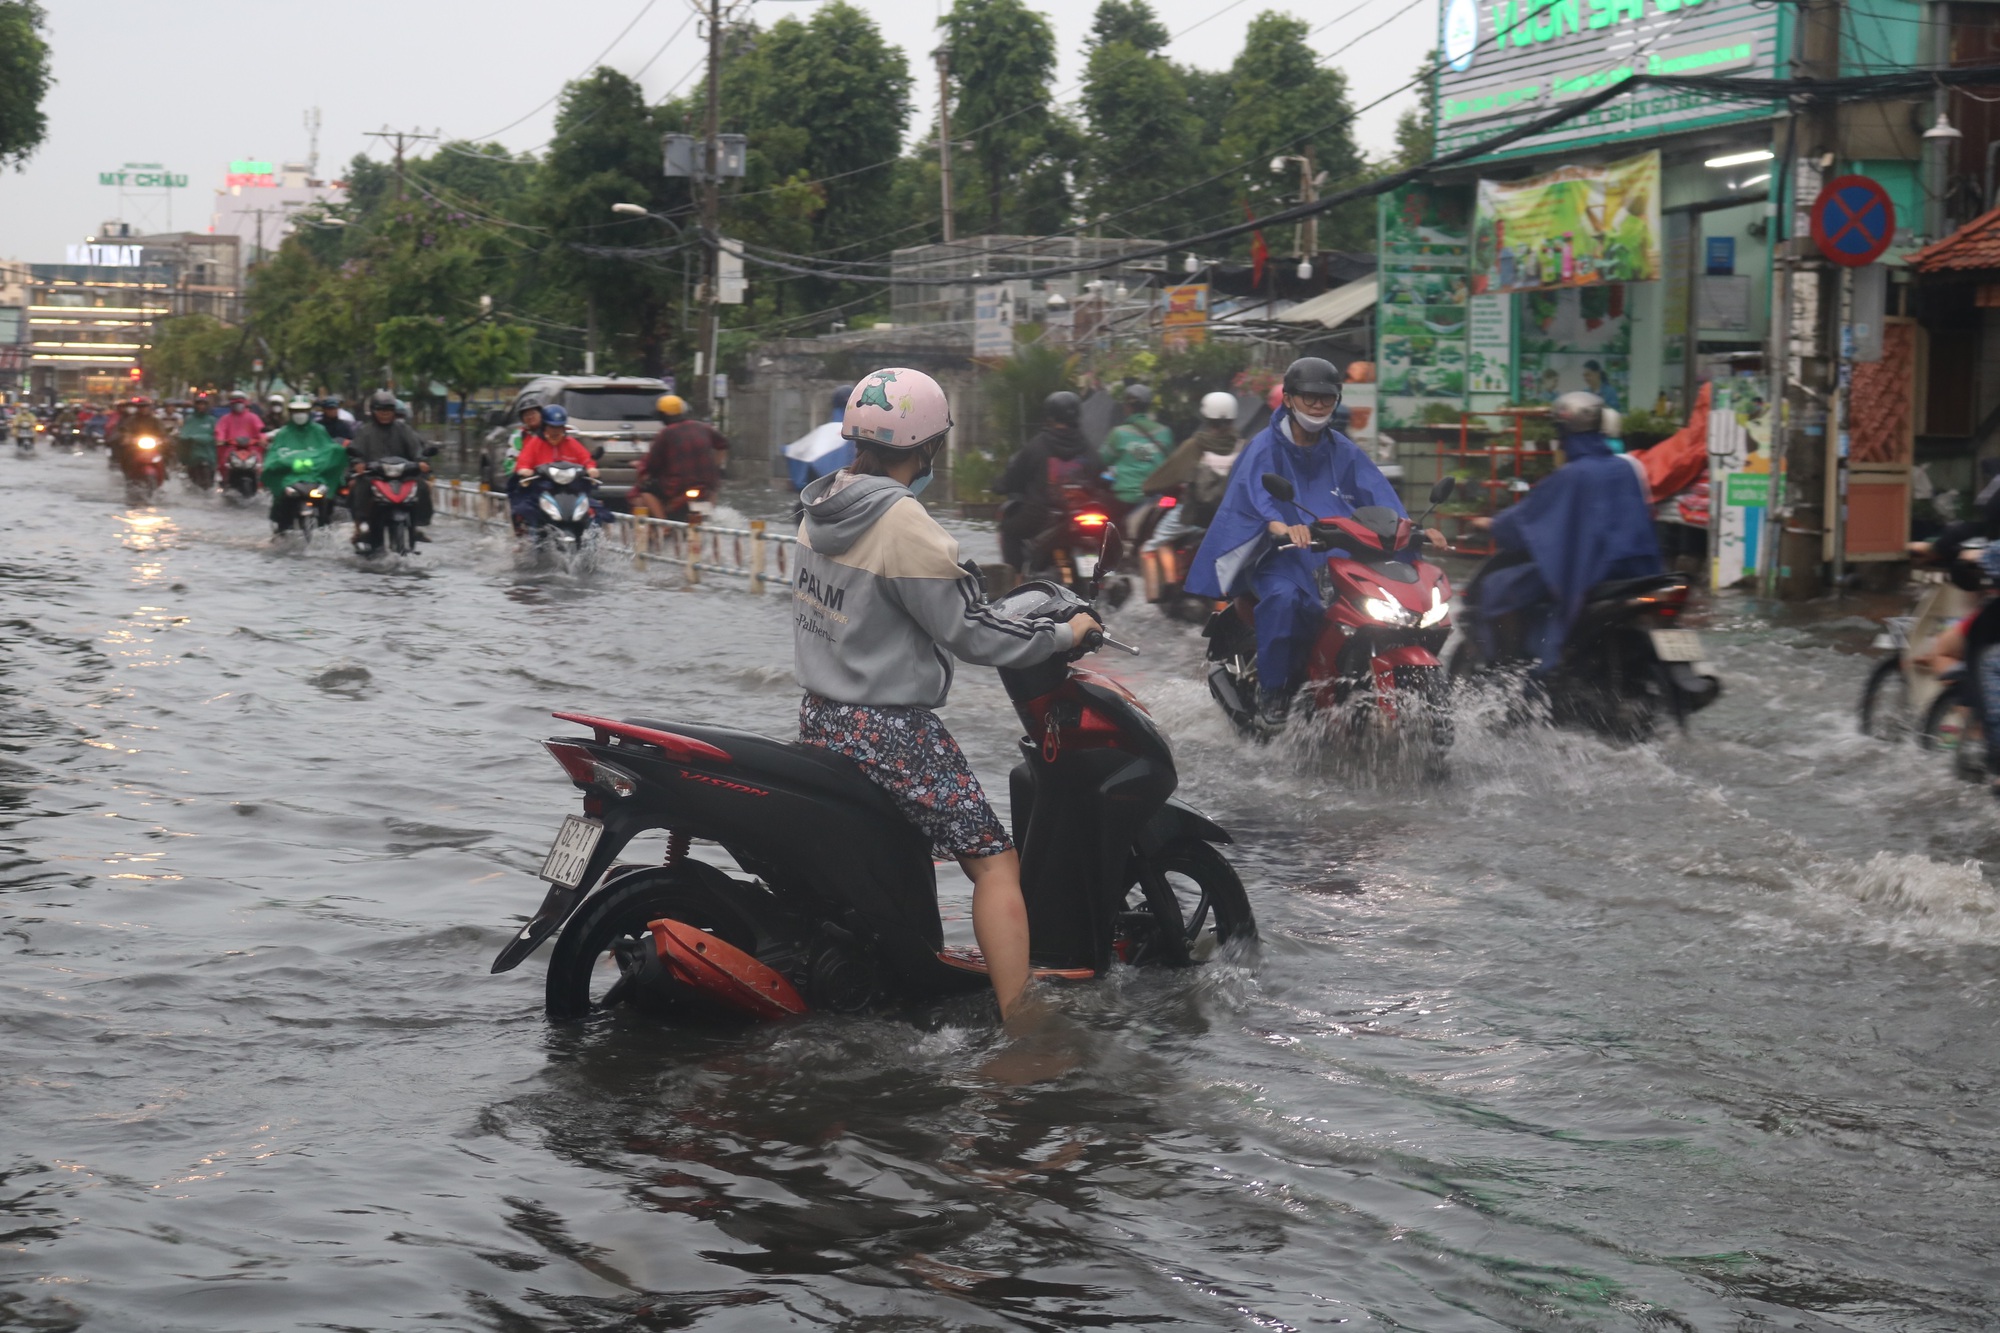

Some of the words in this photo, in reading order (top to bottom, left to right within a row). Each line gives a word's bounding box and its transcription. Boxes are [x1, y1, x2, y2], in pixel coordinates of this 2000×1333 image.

[799, 567, 845, 611] PALM
[680, 770, 769, 796] VISION
[545, 849, 586, 883] 112.40
